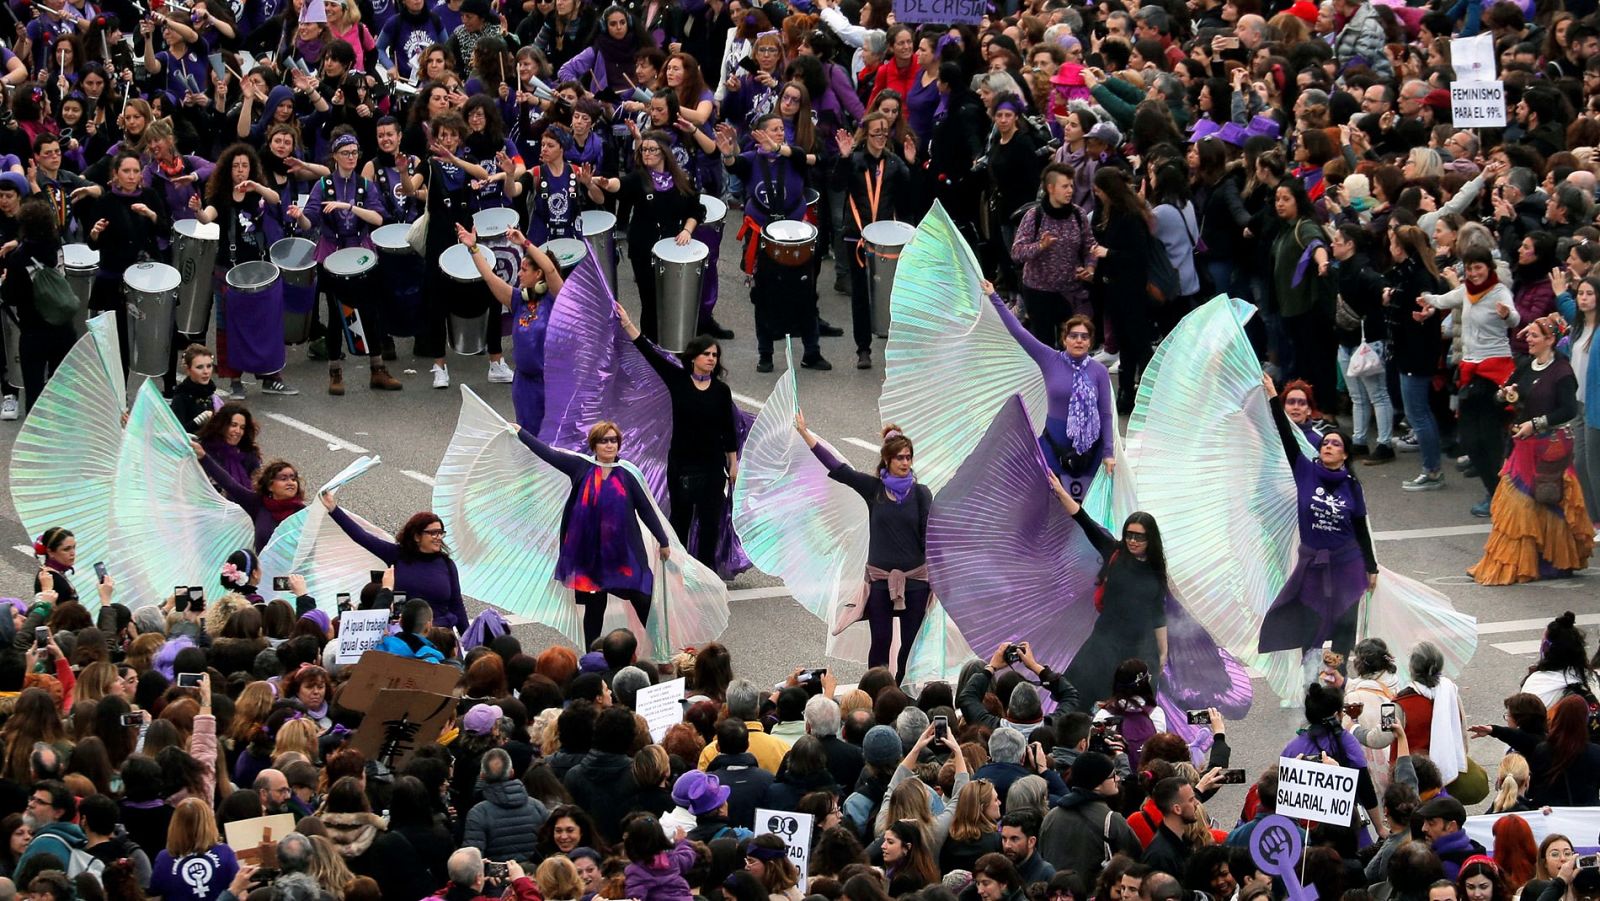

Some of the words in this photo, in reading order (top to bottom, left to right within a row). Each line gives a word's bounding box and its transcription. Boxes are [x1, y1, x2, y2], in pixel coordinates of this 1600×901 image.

[904, 0, 927, 13] DE
[1453, 89, 1501, 100] FEMINISMO
[1454, 107, 1472, 118] PARA
[1474, 107, 1484, 118] EL
[1486, 106, 1502, 118] 99%
[350, 618, 366, 635] igual
[340, 637, 359, 654] igual
[1280, 766, 1353, 793] MALTRATO
[1278, 788, 1327, 815] SALARIAL,
[1330, 798, 1351, 816] NO!
